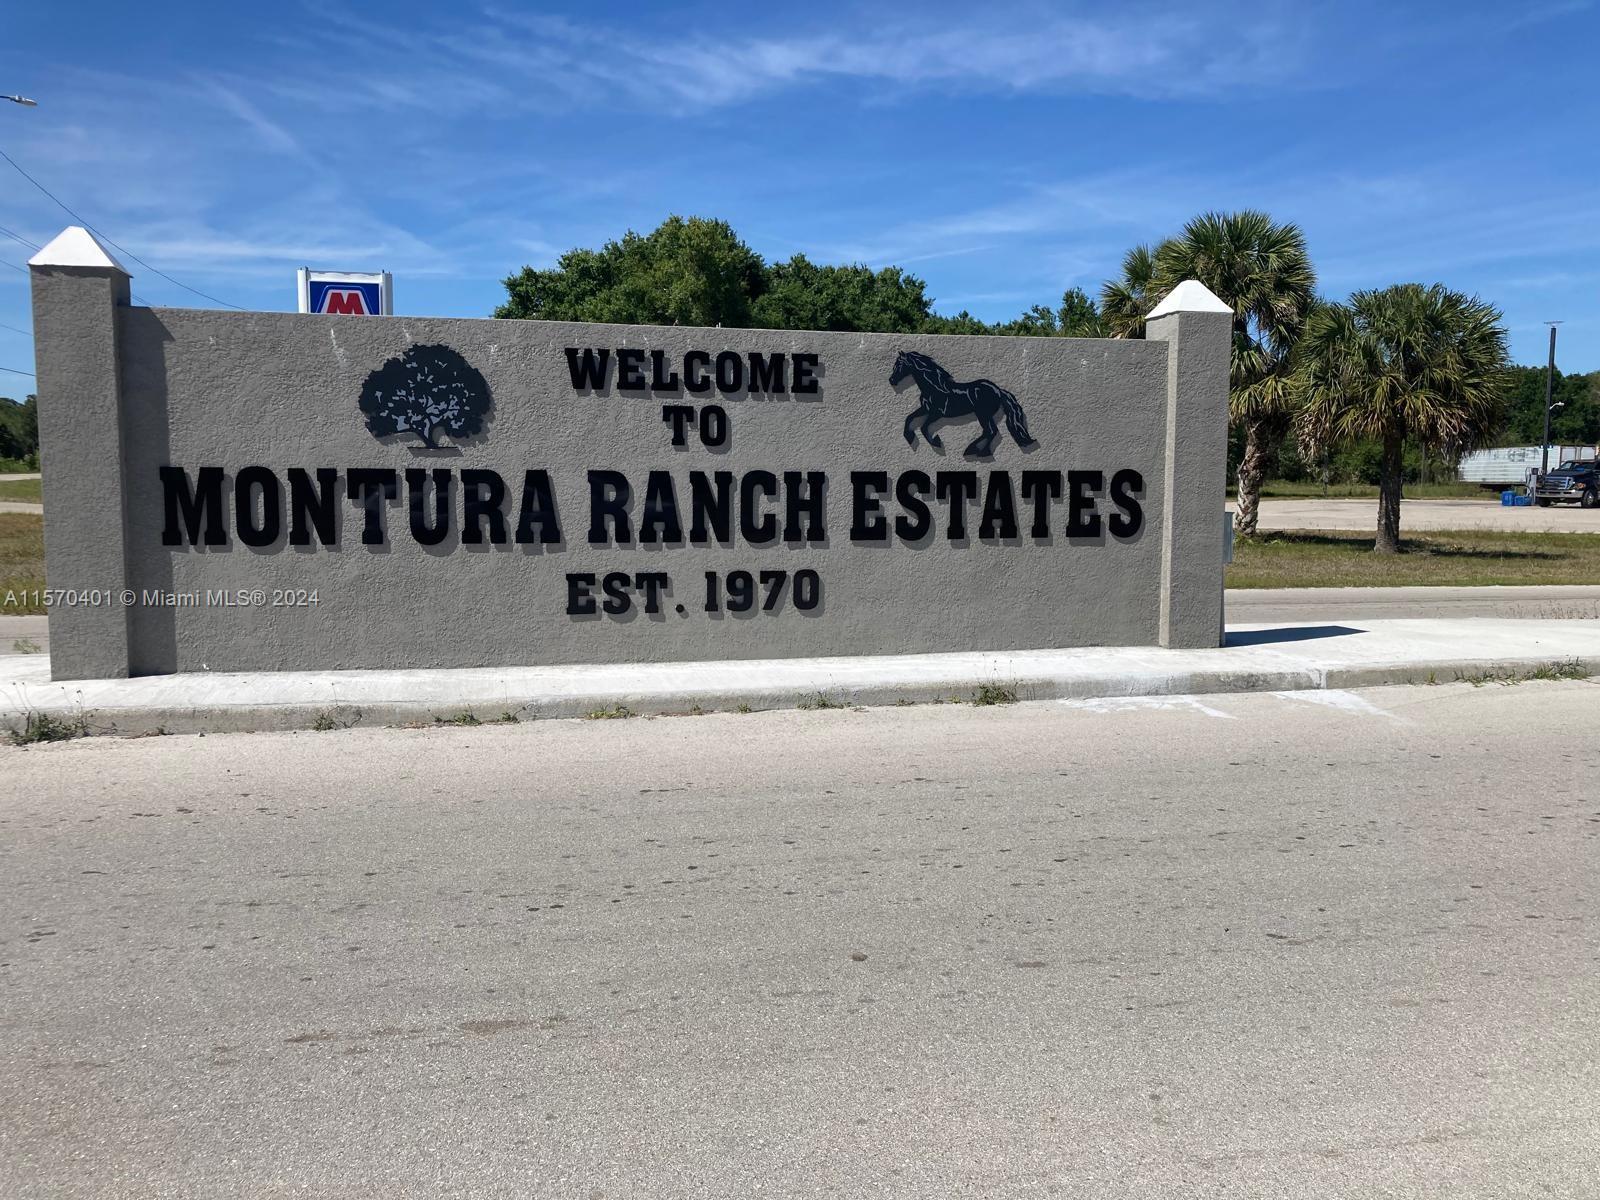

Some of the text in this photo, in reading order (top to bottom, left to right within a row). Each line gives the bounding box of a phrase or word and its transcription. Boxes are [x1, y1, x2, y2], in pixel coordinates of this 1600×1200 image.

[565, 348, 819, 395] WELCOME
[662, 404, 727, 447] TO
[160, 465, 1144, 547] MONTURA RANCH ESTATES
[566, 569, 820, 615] EST. 1970
